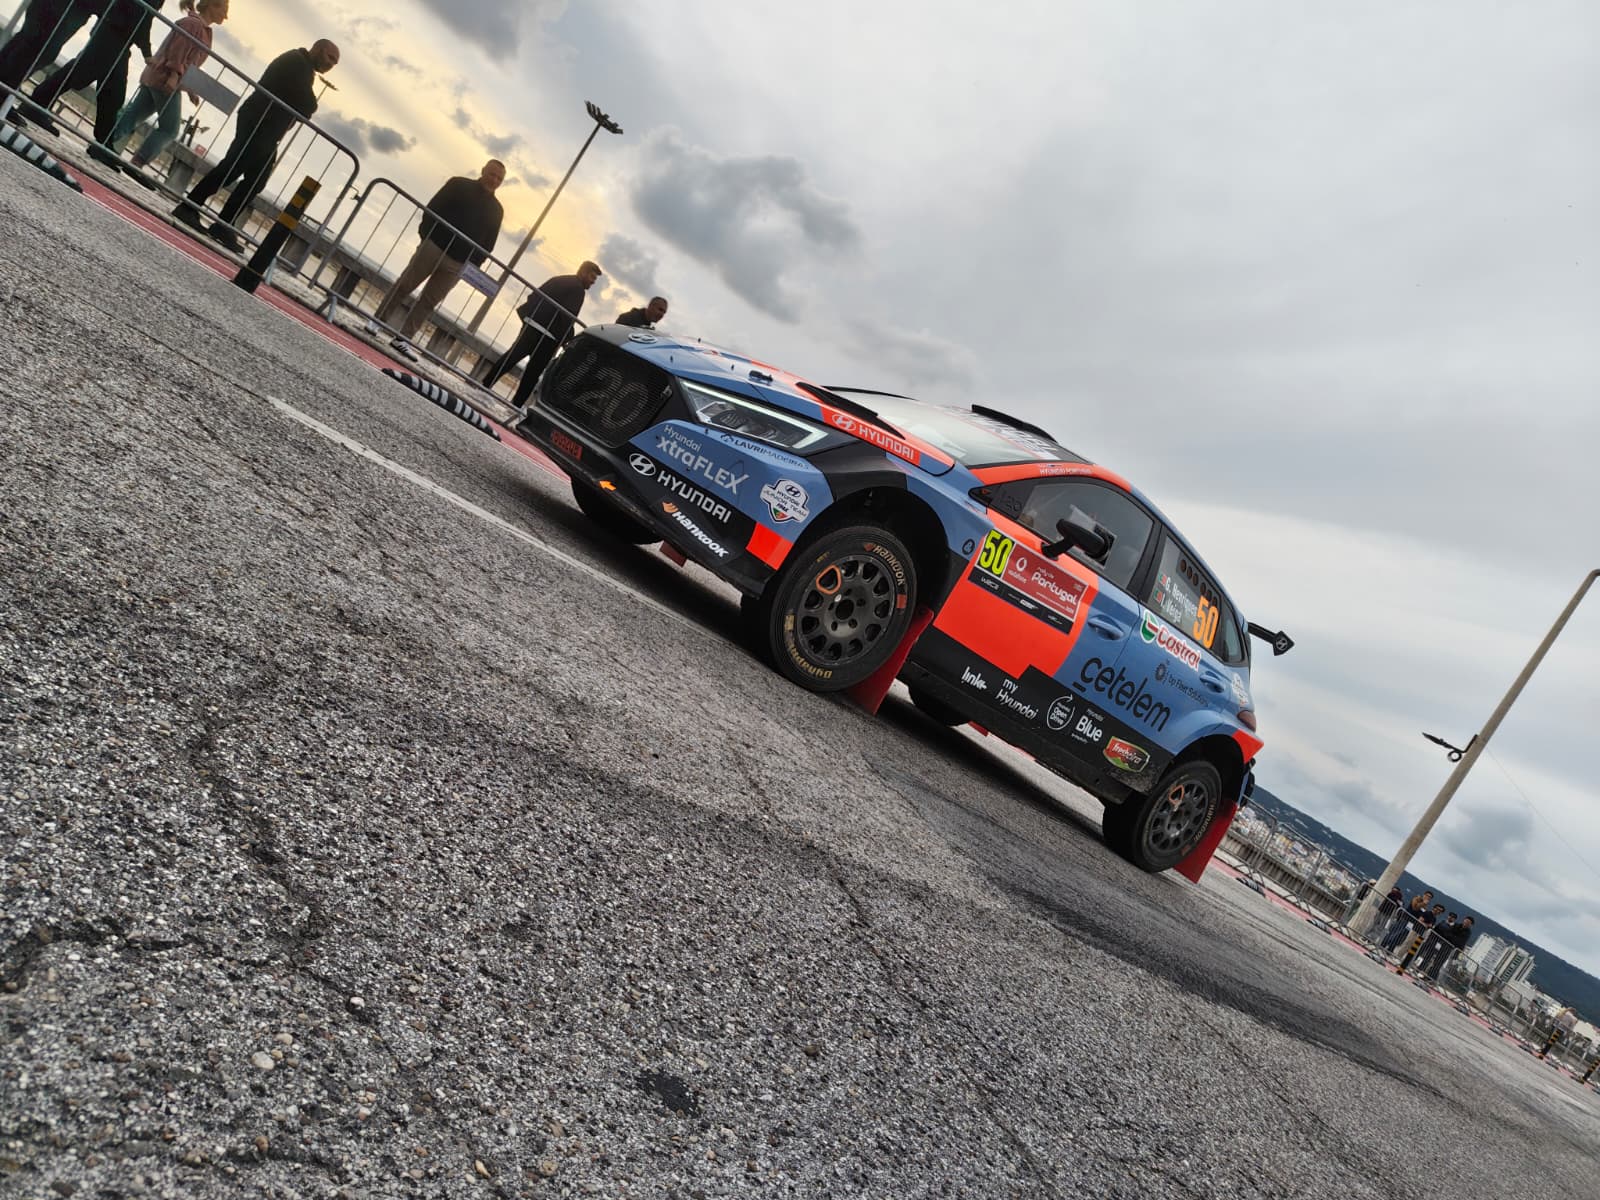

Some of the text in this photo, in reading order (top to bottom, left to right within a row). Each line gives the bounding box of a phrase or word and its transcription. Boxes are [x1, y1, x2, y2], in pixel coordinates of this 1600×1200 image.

[664, 425, 702, 451] Hyundai
[859, 426, 914, 459] HYUNDAI
[656, 436, 750, 495] xtraFLEX
[657, 470, 732, 523] HYUNDAI
[980, 529, 1013, 575] 50
[1031, 571, 1077, 605] Portugal
[1193, 595, 1218, 649] 50
[1157, 626, 1200, 668] Castrol
[995, 689, 1039, 720] Hyundai
[1002, 678, 1018, 694] my
[1080, 657, 1171, 732] cetelem
[1075, 715, 1103, 742] Blue
